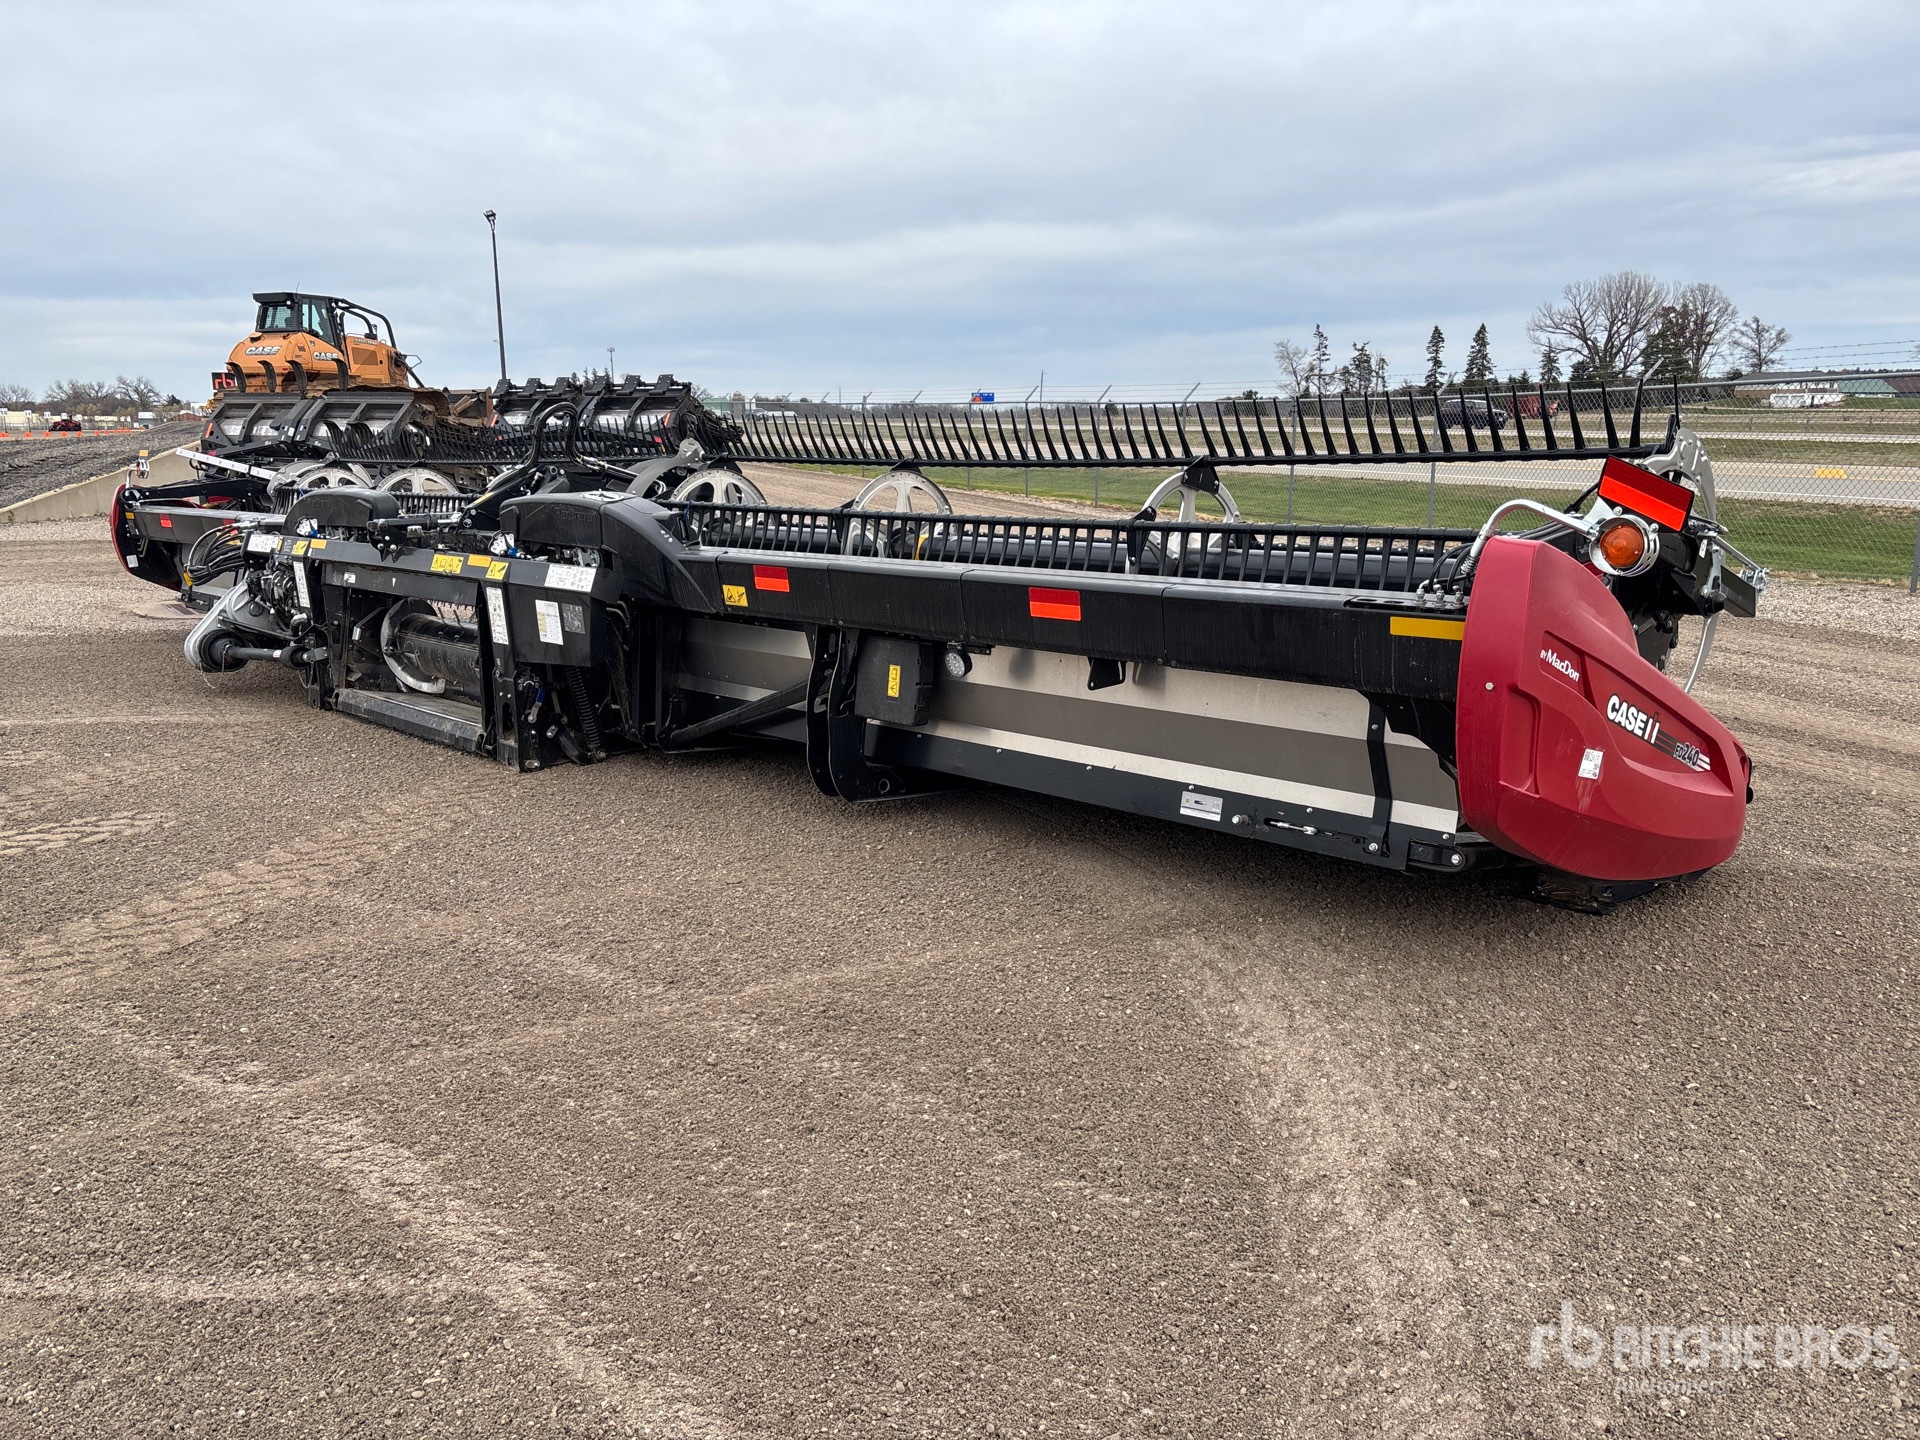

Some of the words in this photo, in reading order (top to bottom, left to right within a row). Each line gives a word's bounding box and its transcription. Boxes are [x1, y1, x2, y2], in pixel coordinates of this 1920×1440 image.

[245, 346, 281, 356] CASE
[313, 351, 340, 361] CASE
[1547, 649, 1580, 682] MacDon
[1607, 694, 1647, 738] CASE
